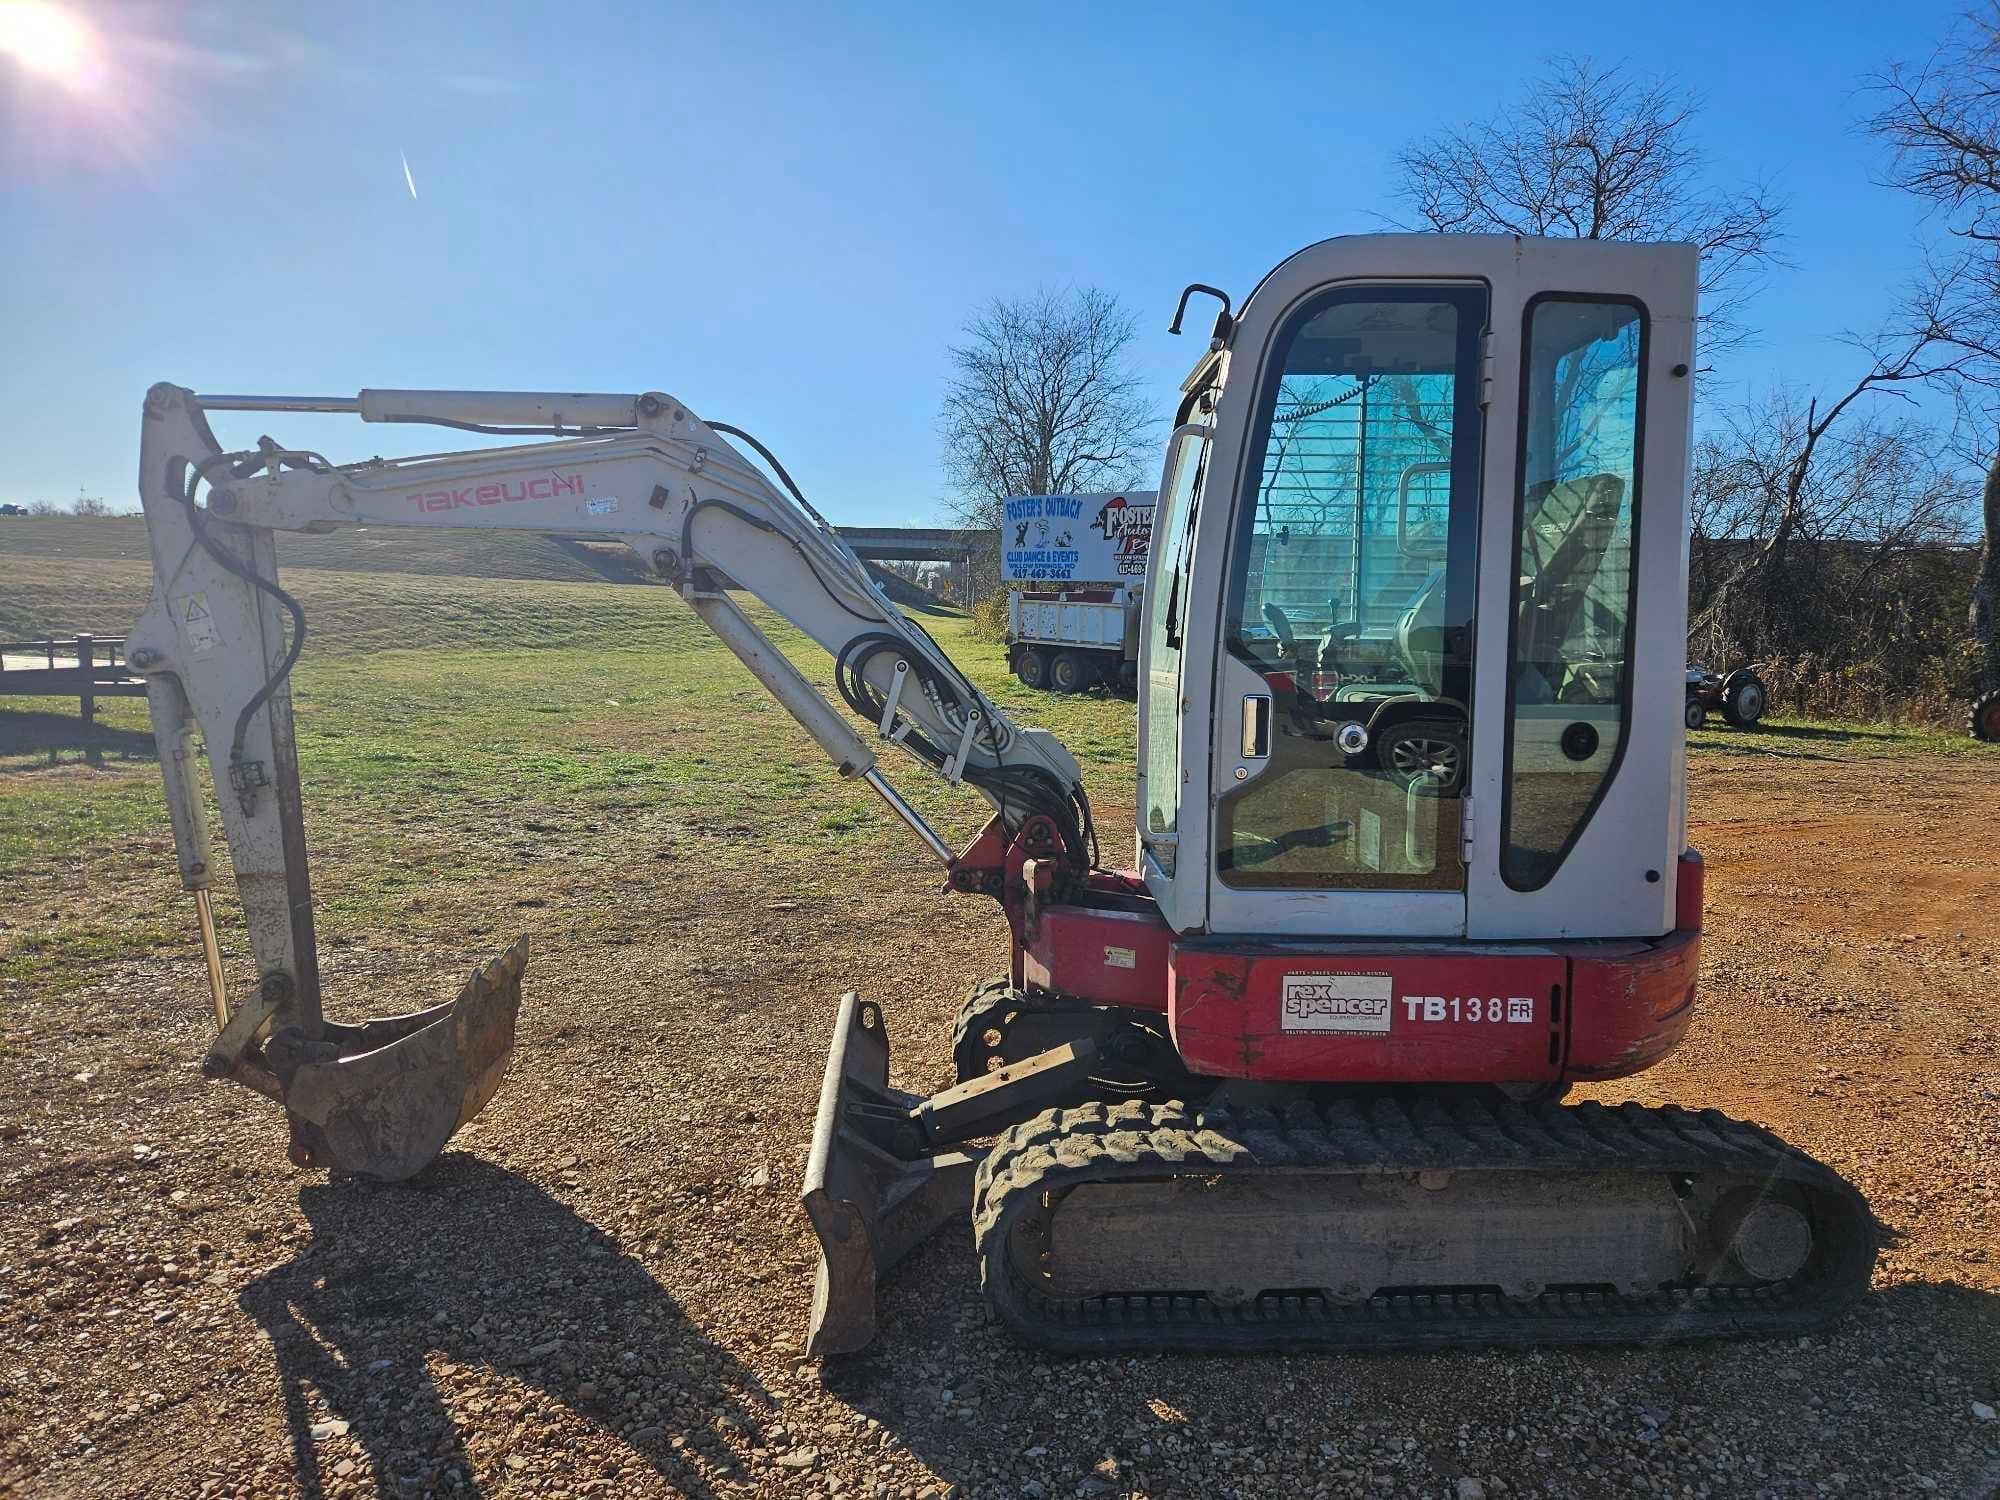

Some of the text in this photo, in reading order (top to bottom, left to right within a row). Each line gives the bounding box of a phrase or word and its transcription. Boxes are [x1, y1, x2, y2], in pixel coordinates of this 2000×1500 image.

[1006, 497, 1083, 520] FOSTER'S OUTBACK
[1006, 551, 1023, 562] CLUB
[1024, 551, 1045, 562] DANCE
[1052, 551, 1079, 562] EVENTS
[1287, 985, 1332, 999] rex
[1286, 998, 1388, 1018] spencer
